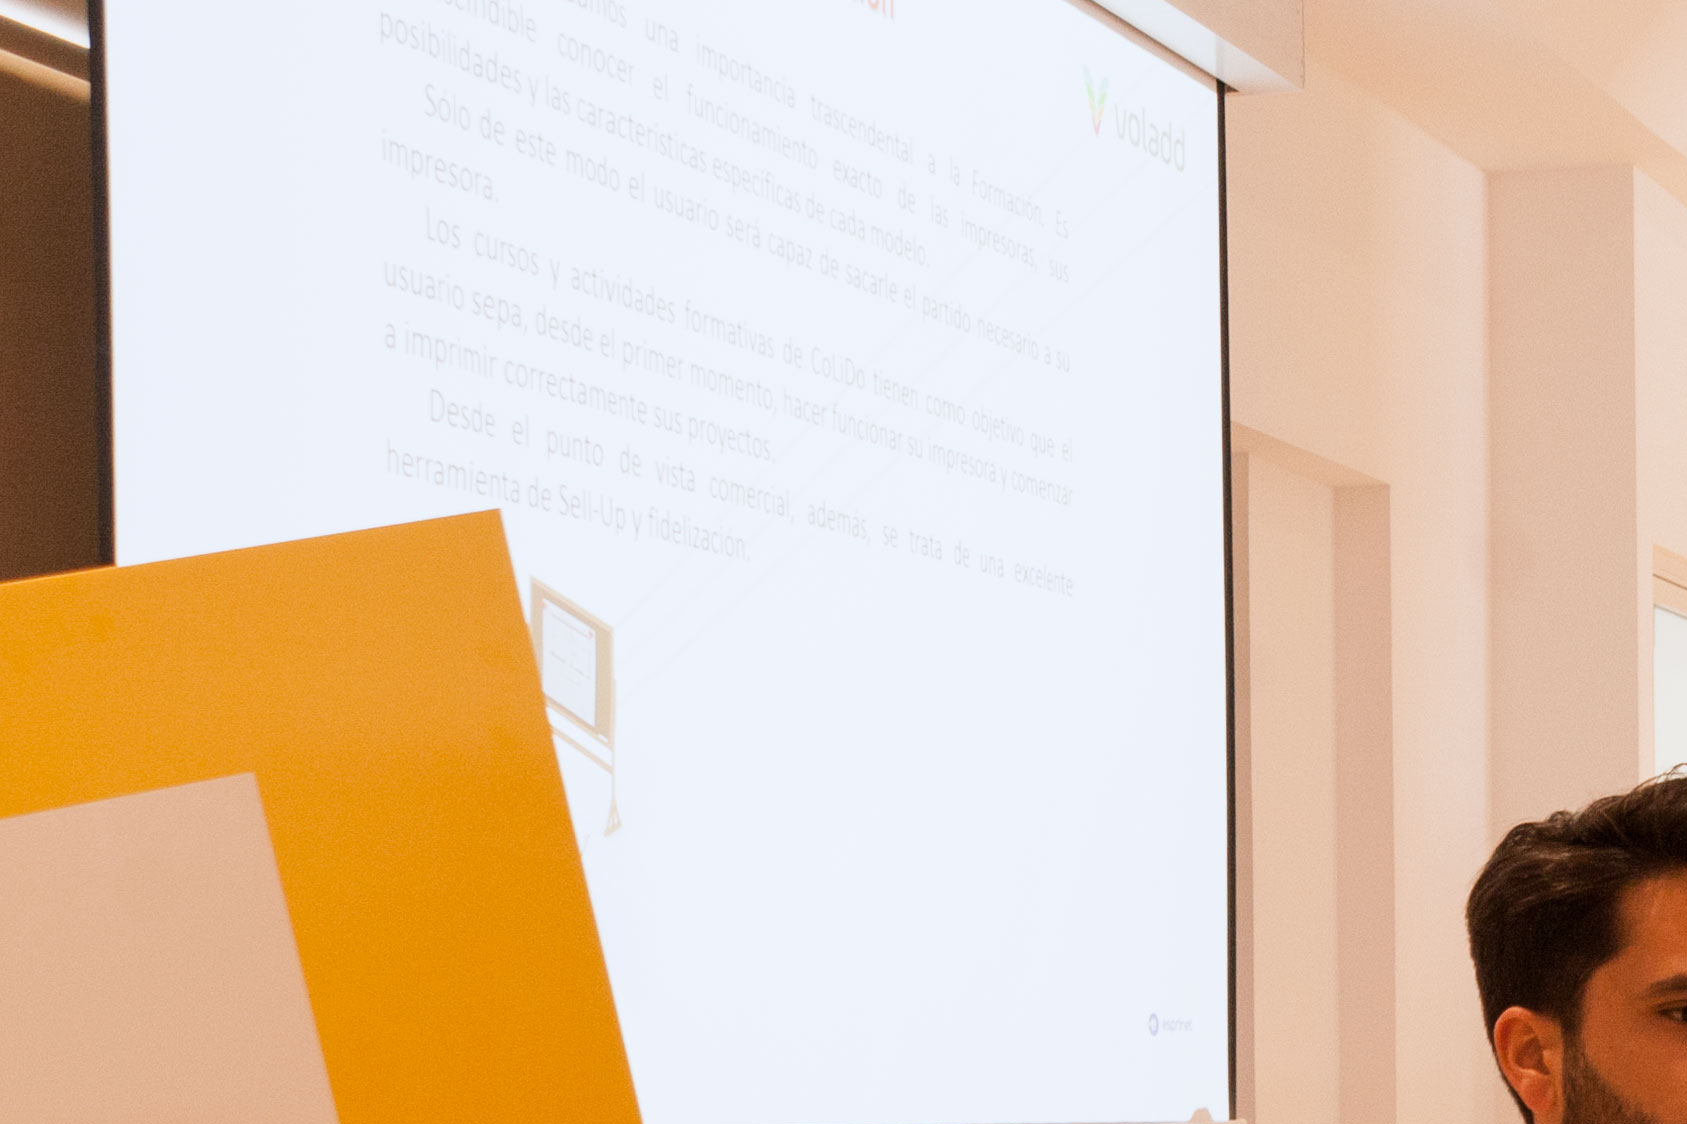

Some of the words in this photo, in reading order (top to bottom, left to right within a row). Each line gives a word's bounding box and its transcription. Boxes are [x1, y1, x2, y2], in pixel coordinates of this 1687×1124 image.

[424, 82, 472, 132] Sólo
[478, 107, 507, 147] de
[514, 128, 557, 168] este
[565, 149, 621, 193] modo
[627, 172, 645, 202] el
[653, 186, 720, 232] usuario
[725, 214, 762, 249] será
[767, 232, 813, 271] capaz
[818, 248, 840, 281] de
[845, 263, 899, 304] sacarle
[903, 284, 916, 310] el
[921, 295, 972, 334] partido
[977, 317, 1040, 361] necesario
[1043, 345, 1052, 366] a
[1056, 351, 1071, 374] su
[526, 75, 539, 108] y
[544, 75, 572, 116] las
[804, 192, 826, 225] de
[829, 207, 866, 242] cada
[870, 224, 930, 269] modelo.
[556, 32, 635, 85] conocer
[651, 72, 669, 102] el
[832, 159, 883, 200] exacto
[897, 183, 917, 215] de
[930, 196, 949, 229] las
[1048, 258, 1070, 284] sus
[645, 18, 679, 53] una
[927, 153, 937, 176] a
[949, 157, 961, 187] la
[1055, 209, 1070, 240] Es
[1113, 102, 1186, 173] voladd
[383, 261, 465, 311] usuario
[471, 290, 529, 337] sepa,
[535, 304, 594, 352] desde
[599, 327, 616, 359] el
[622, 340, 685, 380] primer
[690, 362, 778, 416] momento,
[783, 387, 830, 427] hacer
[829, 401, 904, 452] funcionar
[907, 435, 923, 460] su
[928, 443, 997, 484] impresora
[1000, 467, 1008, 491] y
[1011, 470, 1074, 507] comenzar
[384, 322, 397, 350] a
[404, 320, 498, 379] imprimir
[653, 405, 683, 436] sus
[425, 206, 462, 250] Los
[472, 230, 540, 277] cursos
[548, 258, 561, 291] y
[782, 336, 803, 370] de
[872, 370, 919, 409] tienen
[925, 393, 966, 425] como
[972, 408, 1024, 447] objetivo
[1029, 432, 1057, 458] que
[1060, 439, 1074, 464] el
[429, 387, 497, 439] Desde
[511, 414, 530, 447] el
[545, 429, 605, 468] punto
[619, 443, 642, 478] de
[654, 461, 696, 493] vista
[806, 500, 871, 544] además,
[882, 524, 899, 549] se
[908, 529, 943, 561] trata
[953, 540, 971, 569] de
[979, 554, 1005, 579] una
[1014, 562, 1074, 598] excelente
[527, 476, 552, 513] de
[557, 482, 627, 536] Sell-Up
[631, 509, 643, 542] y
